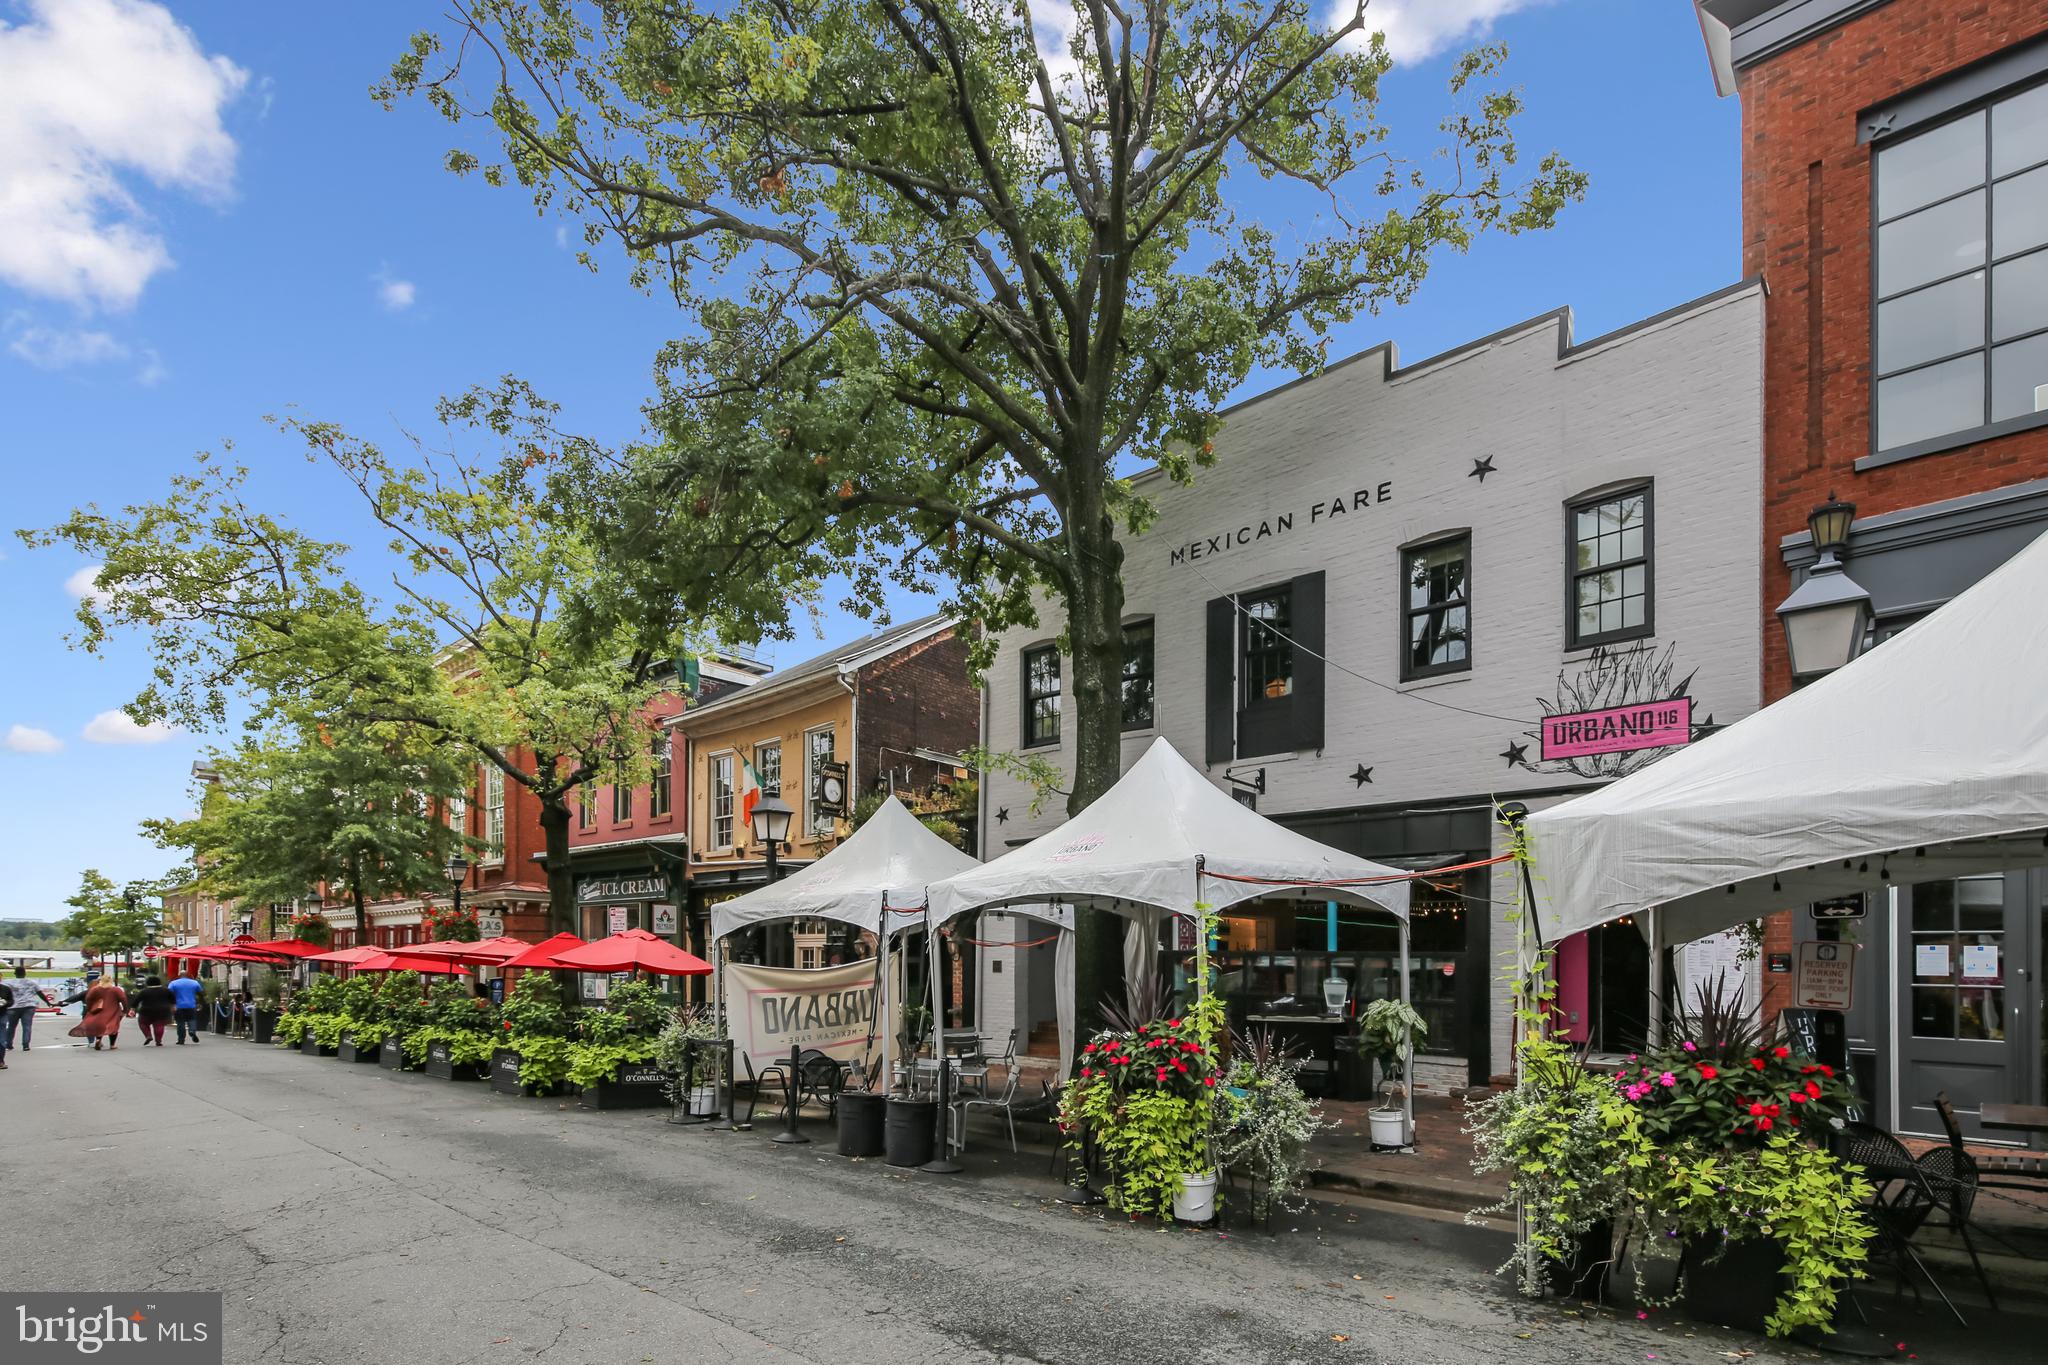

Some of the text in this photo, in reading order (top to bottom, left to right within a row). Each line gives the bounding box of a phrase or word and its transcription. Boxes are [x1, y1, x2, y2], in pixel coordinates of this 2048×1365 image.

[1170, 480, 1393, 567] MEXICAN FARE
[1553, 710, 1655, 746] URBANO
[1658, 709, 1678, 725] 116
[602, 881, 620, 896] ICE
[620, 878, 664, 895] CREAM
[1804, 960, 1848, 970] RESERVED
[1806, 968, 1844, 978] PARKING
[625, 1074, 665, 1082] O'CONNELL'S
